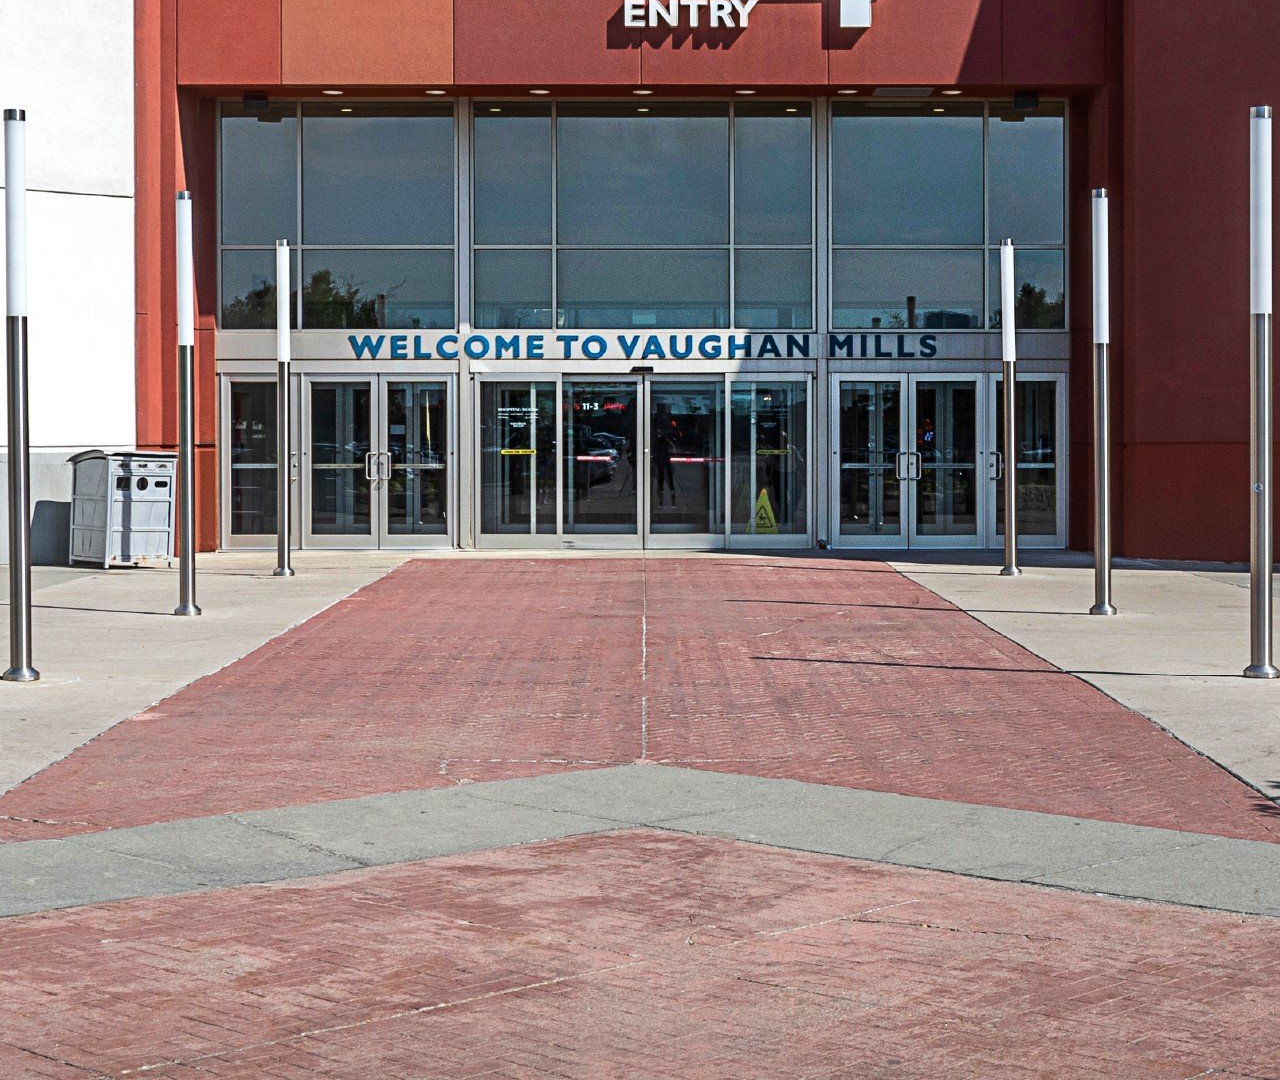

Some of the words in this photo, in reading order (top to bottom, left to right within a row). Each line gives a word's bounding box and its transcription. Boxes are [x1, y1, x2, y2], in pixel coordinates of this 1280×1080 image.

[348, 334, 545, 360] WELCOME
[556, 334, 609, 360] TO
[617, 334, 811, 360] VAUGHAN
[829, 334, 938, 358] MILLS
